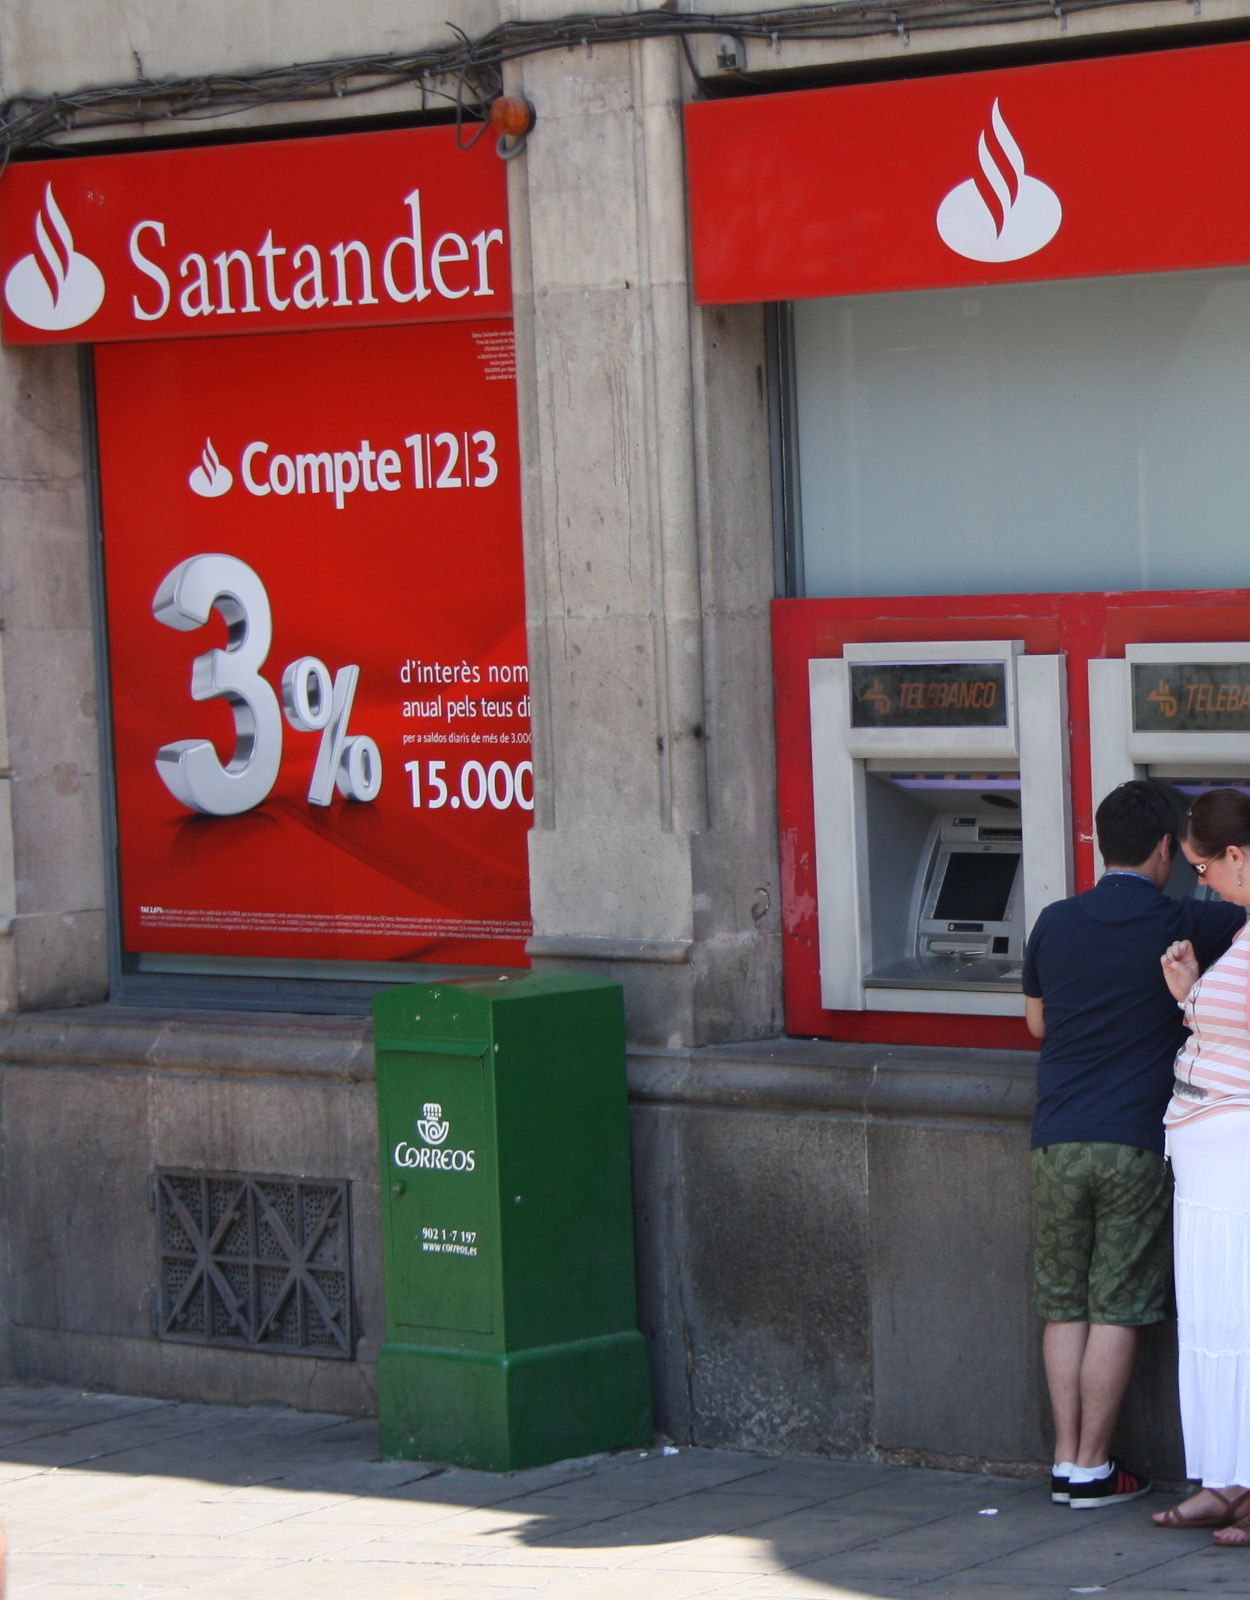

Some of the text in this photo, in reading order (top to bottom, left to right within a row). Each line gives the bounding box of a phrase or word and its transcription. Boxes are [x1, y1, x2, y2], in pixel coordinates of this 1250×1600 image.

[129, 188, 503, 321] Santander
[242, 439, 402, 510] Compte
[152, 553, 382, 816] 3%
[400, 659, 529, 683] d'interès nom
[402, 695, 442, 718] anual
[447, 695, 477, 723] pels
[481, 697, 513, 718] teus
[899, 682, 997, 710] TELEBANCO
[403, 733, 415, 745] per
[417, 735, 422, 743] a
[423, 732, 447, 743] saldos
[449, 732, 470, 743] diaris
[471, 732, 480, 743] de
[482, 732, 498, 743] més
[500, 732, 509, 743] de
[404, 760, 534, 811] 15.000
[394, 1142, 476, 1172] CORREOS
[422, 1227, 439, 1240] 902
[461, 1231, 477, 1243] 197
